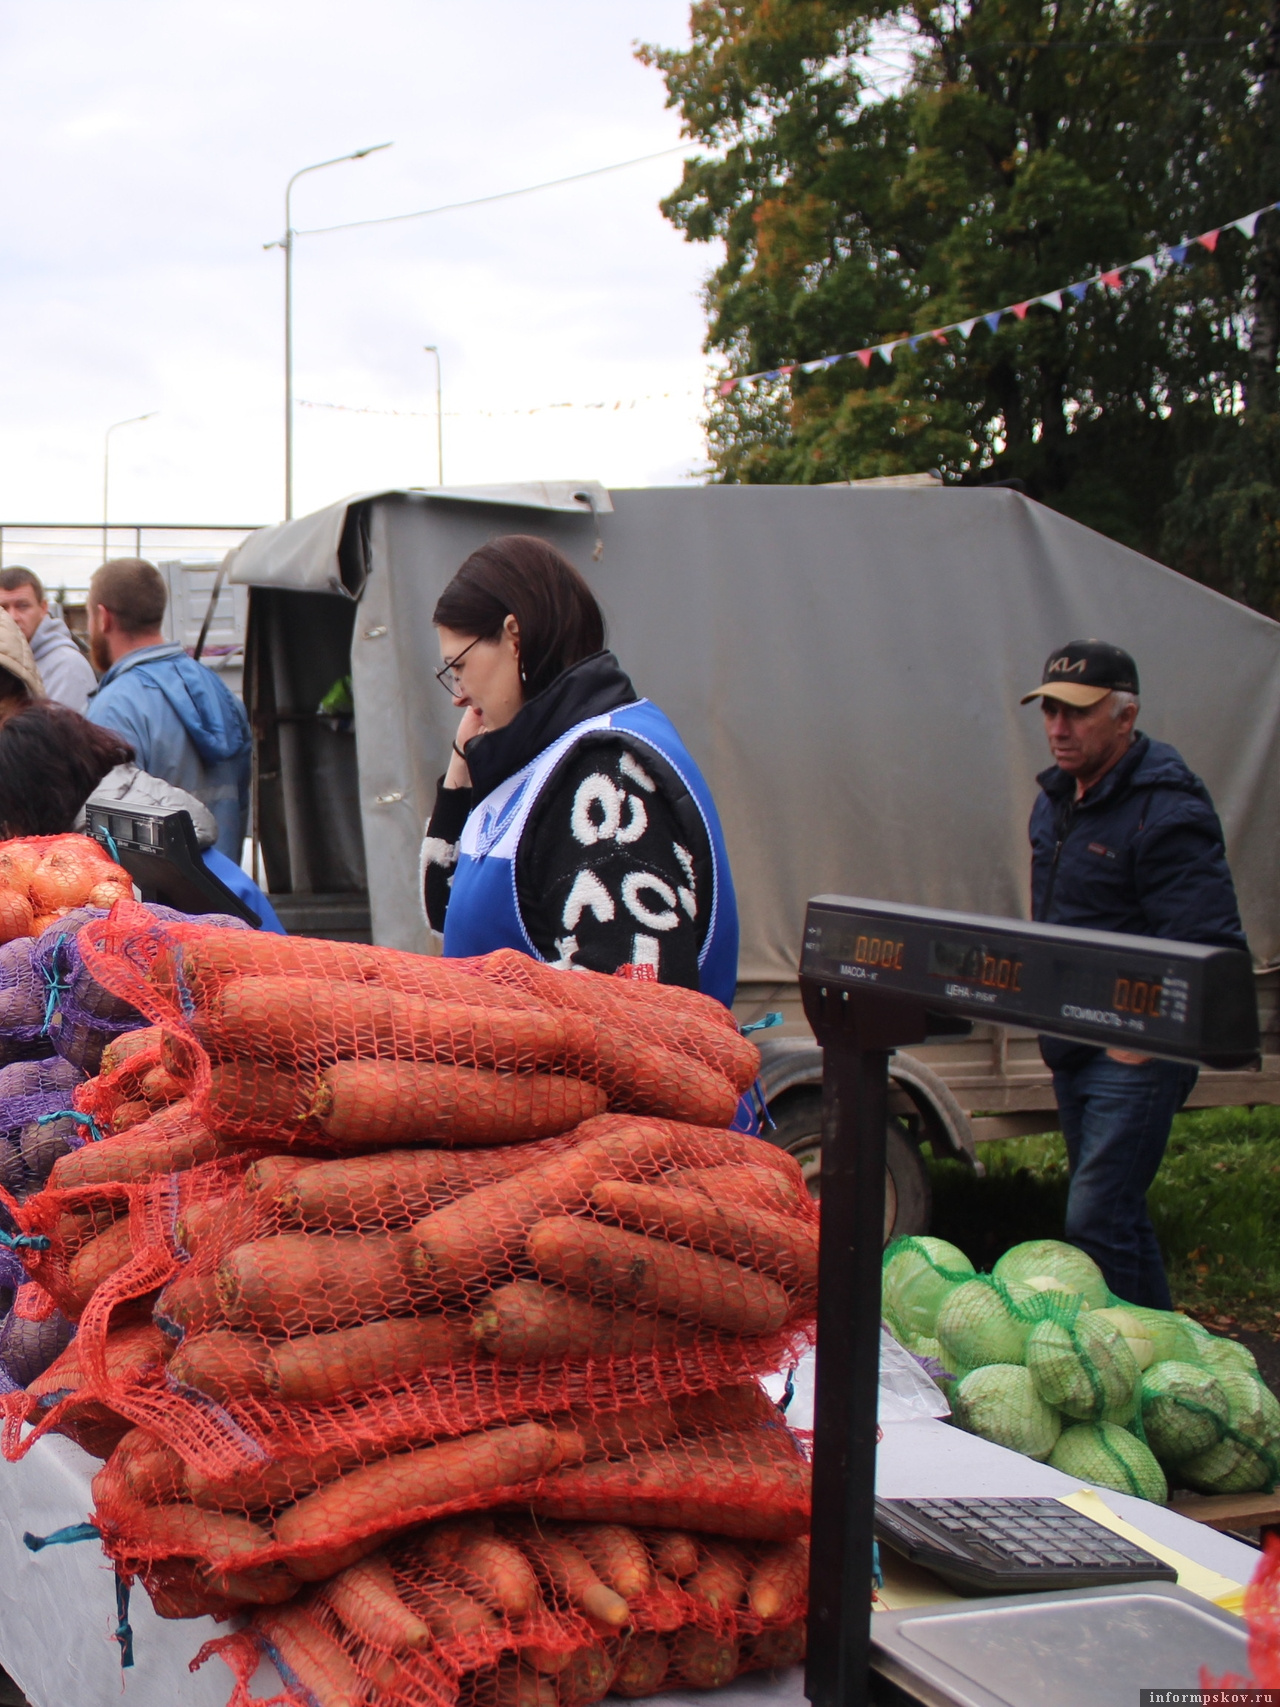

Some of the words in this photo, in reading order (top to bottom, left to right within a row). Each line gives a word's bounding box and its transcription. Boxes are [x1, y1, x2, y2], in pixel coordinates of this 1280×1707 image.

[840, 964, 866, 979] МАССА
[945, 983, 970, 998] ЦЕНА
[1061, 1003, 1122, 1027] СТОИМОСТЬ
